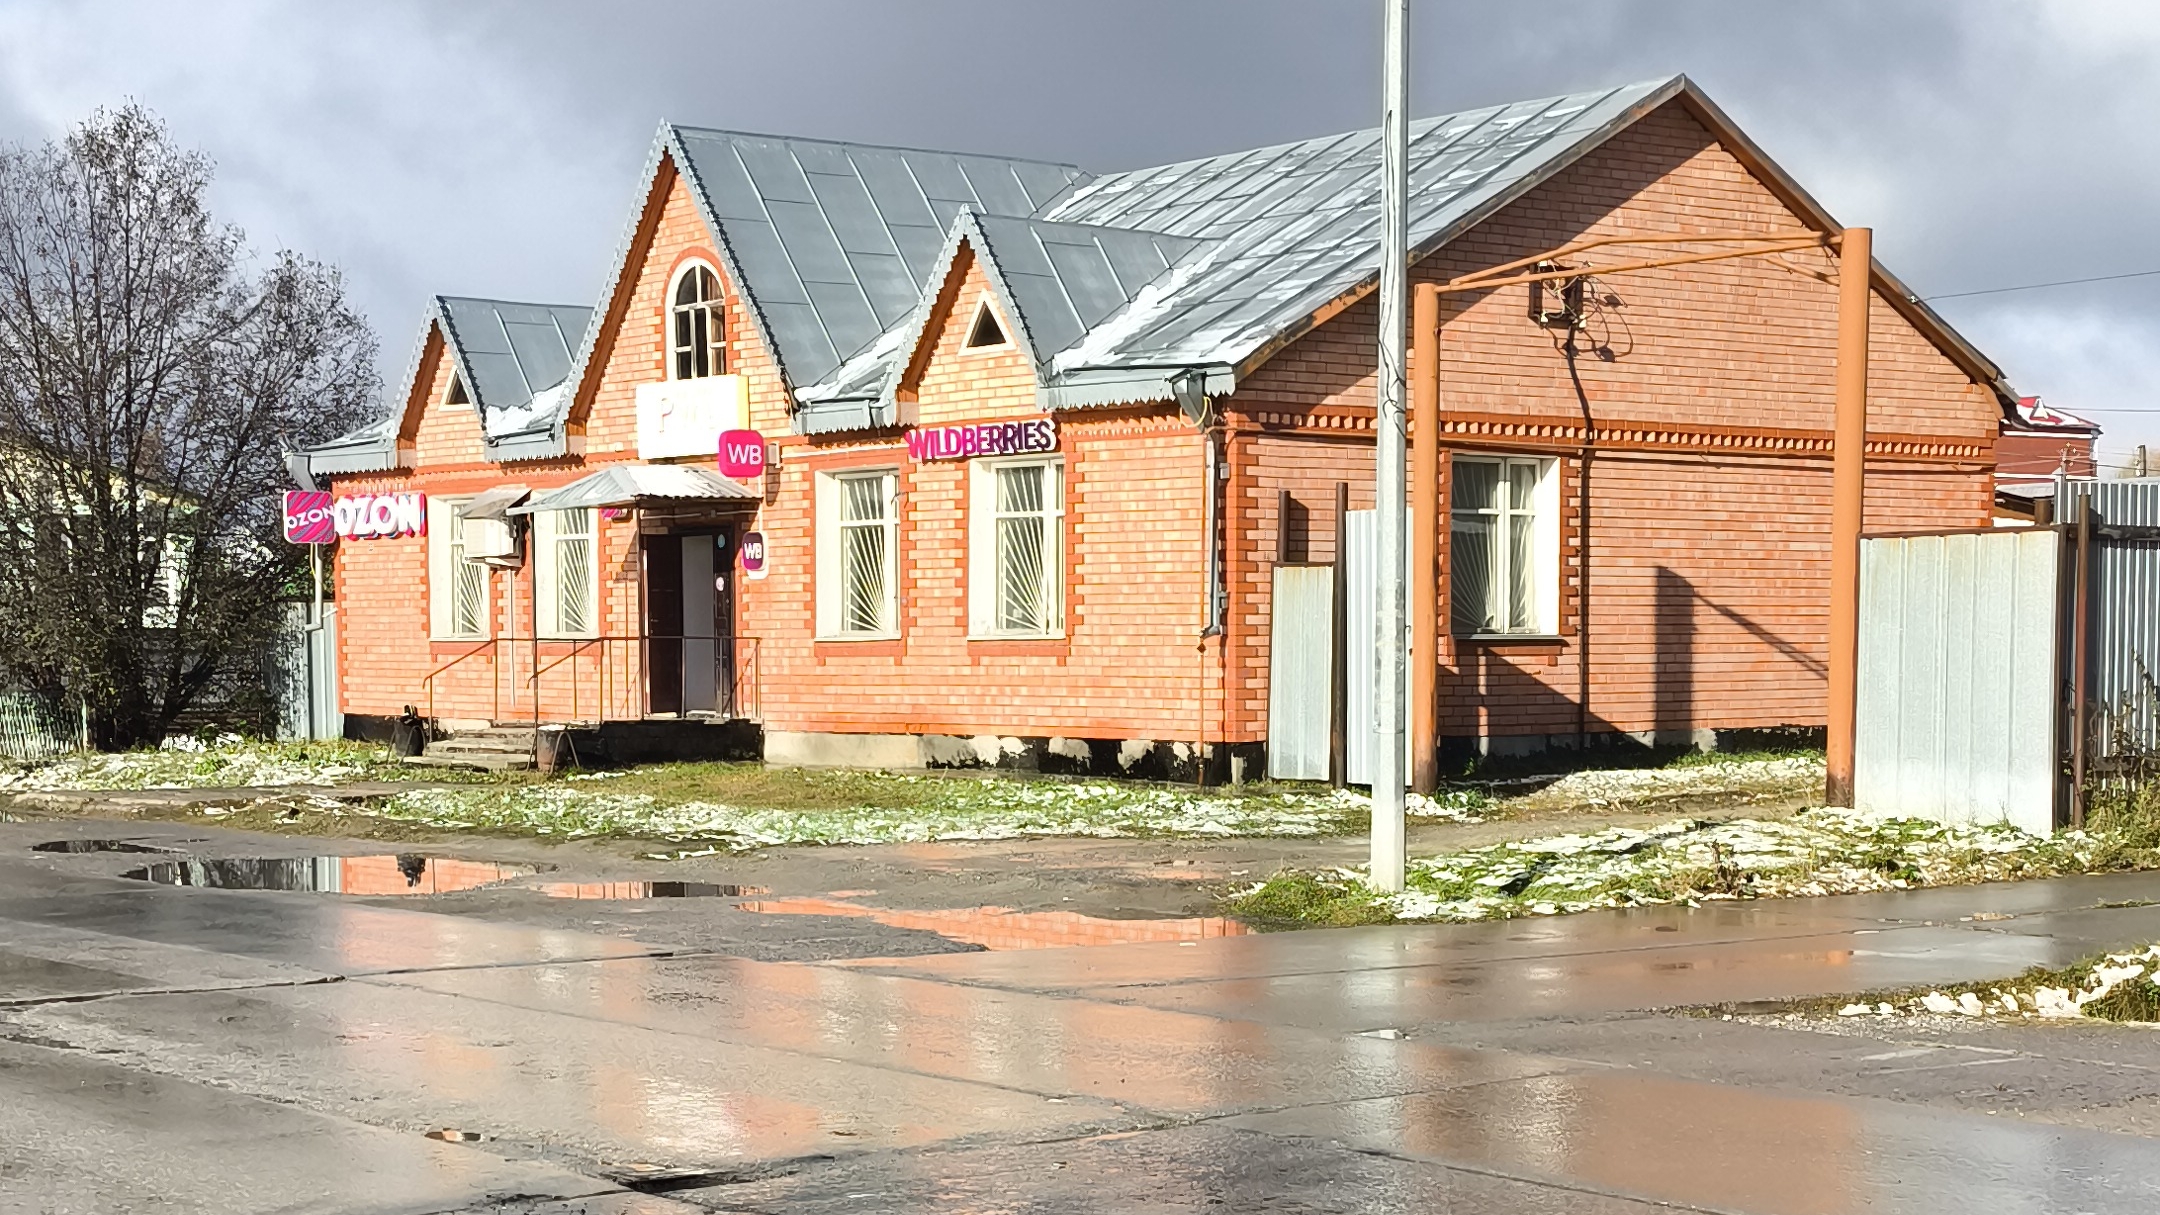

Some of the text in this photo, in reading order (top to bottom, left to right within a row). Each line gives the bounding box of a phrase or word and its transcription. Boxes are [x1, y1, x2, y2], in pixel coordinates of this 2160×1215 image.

[905, 420, 1054, 459] WILDBERRIES
[728, 443, 763, 465] WB
[288, 505, 334, 529] OZON
[334, 494, 421, 536] OZON
[743, 542, 763, 560] WB
